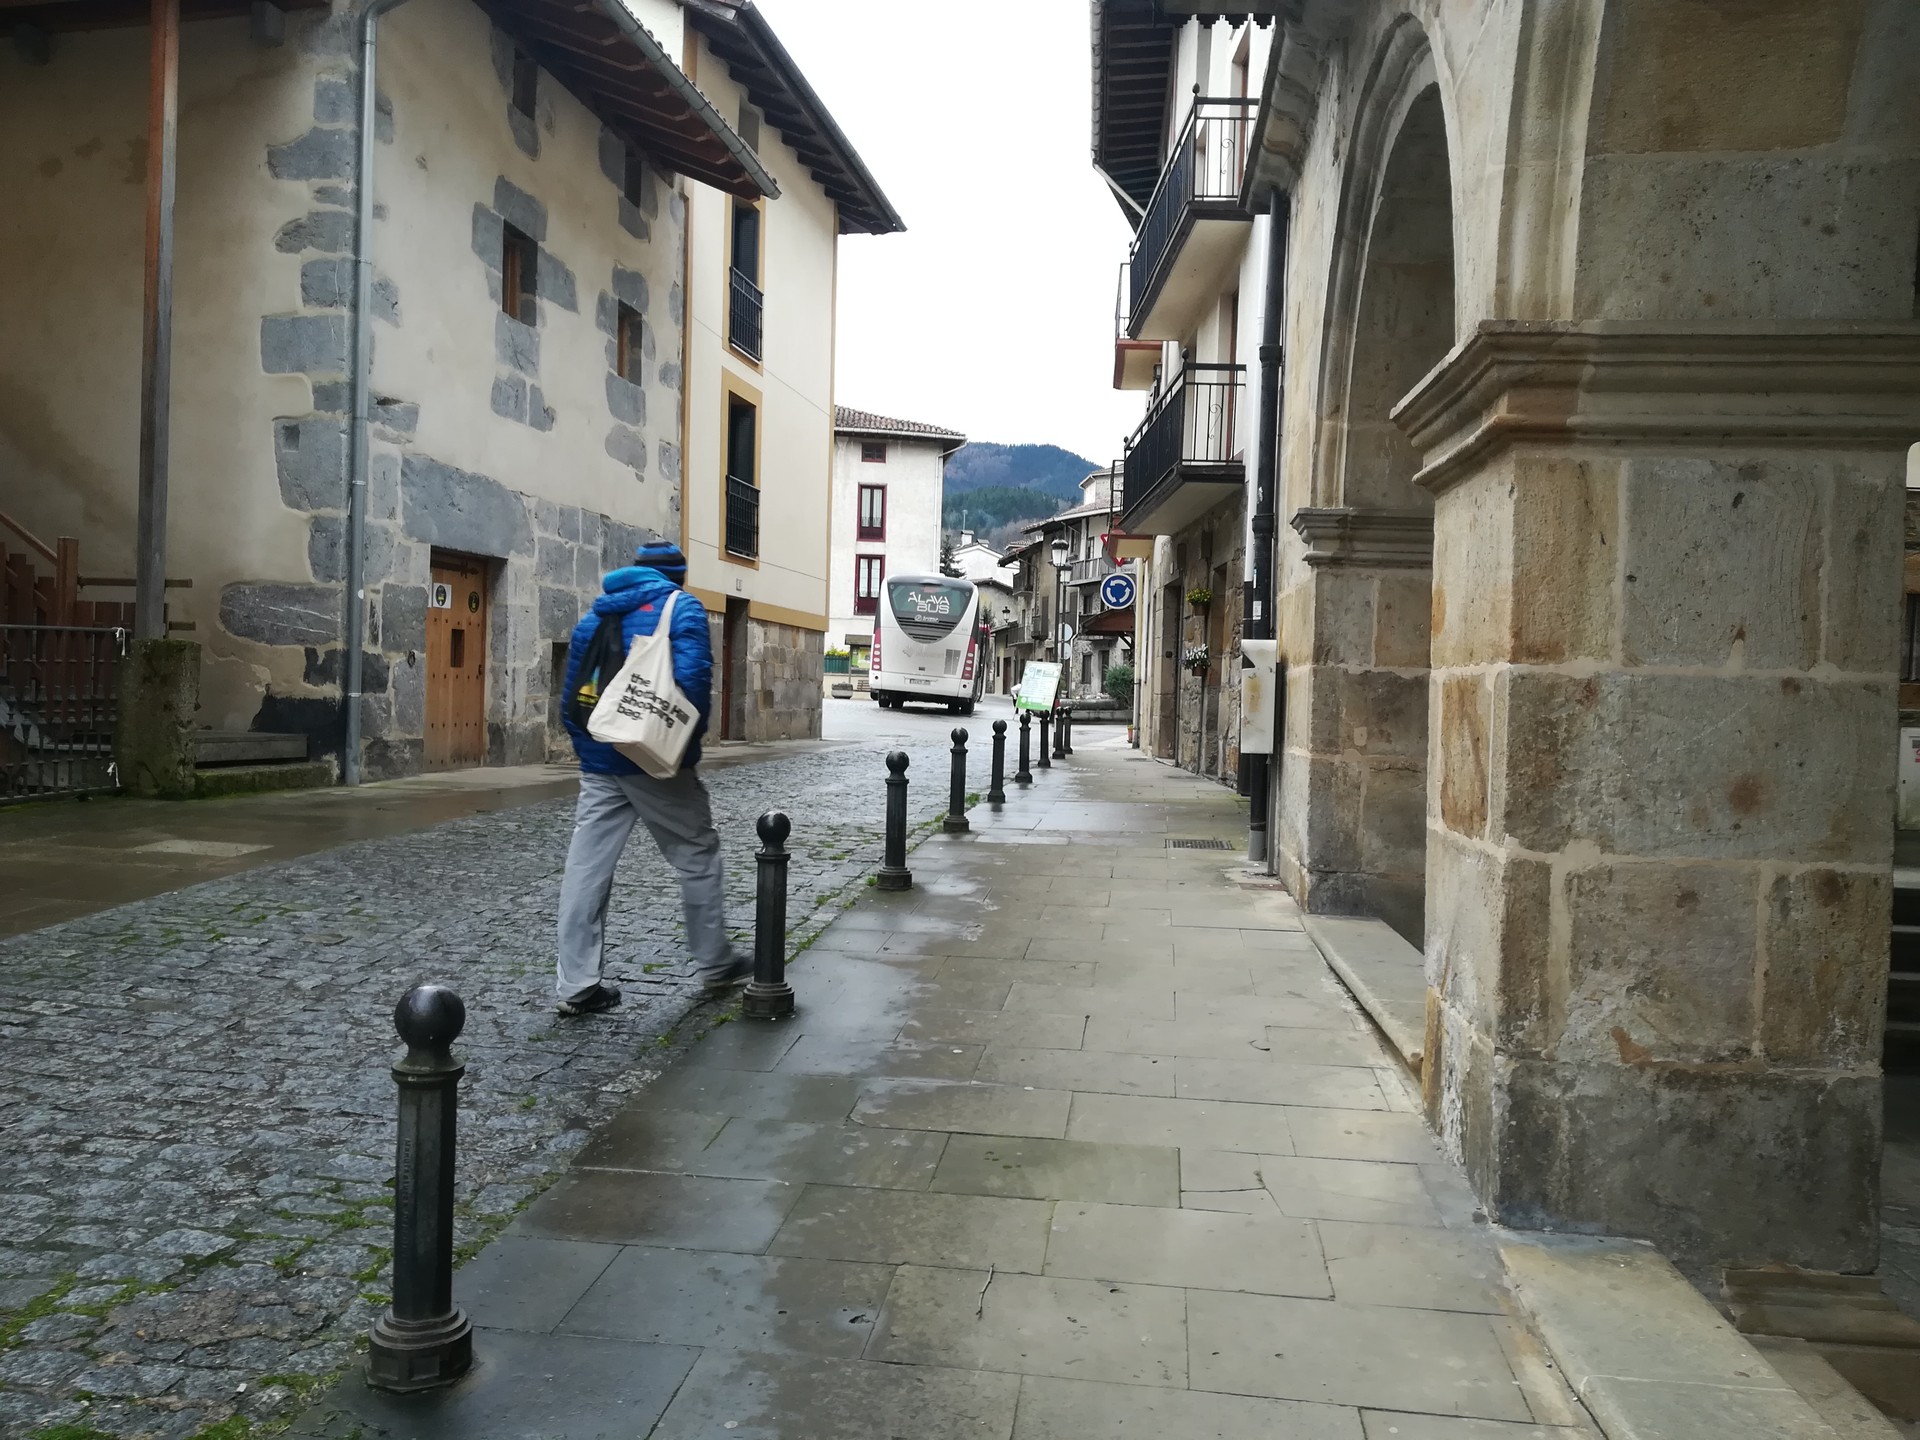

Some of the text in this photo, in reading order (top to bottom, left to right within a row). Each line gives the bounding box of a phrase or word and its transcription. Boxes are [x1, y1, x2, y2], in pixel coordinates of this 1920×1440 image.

[917, 602, 950, 614] BUS
[631, 673, 651, 687] the
[617, 703, 643, 720] bag.
[620, 695, 676, 728] shopping
[625, 683, 670, 711] Notting
[670, 704, 690, 726] Hill
